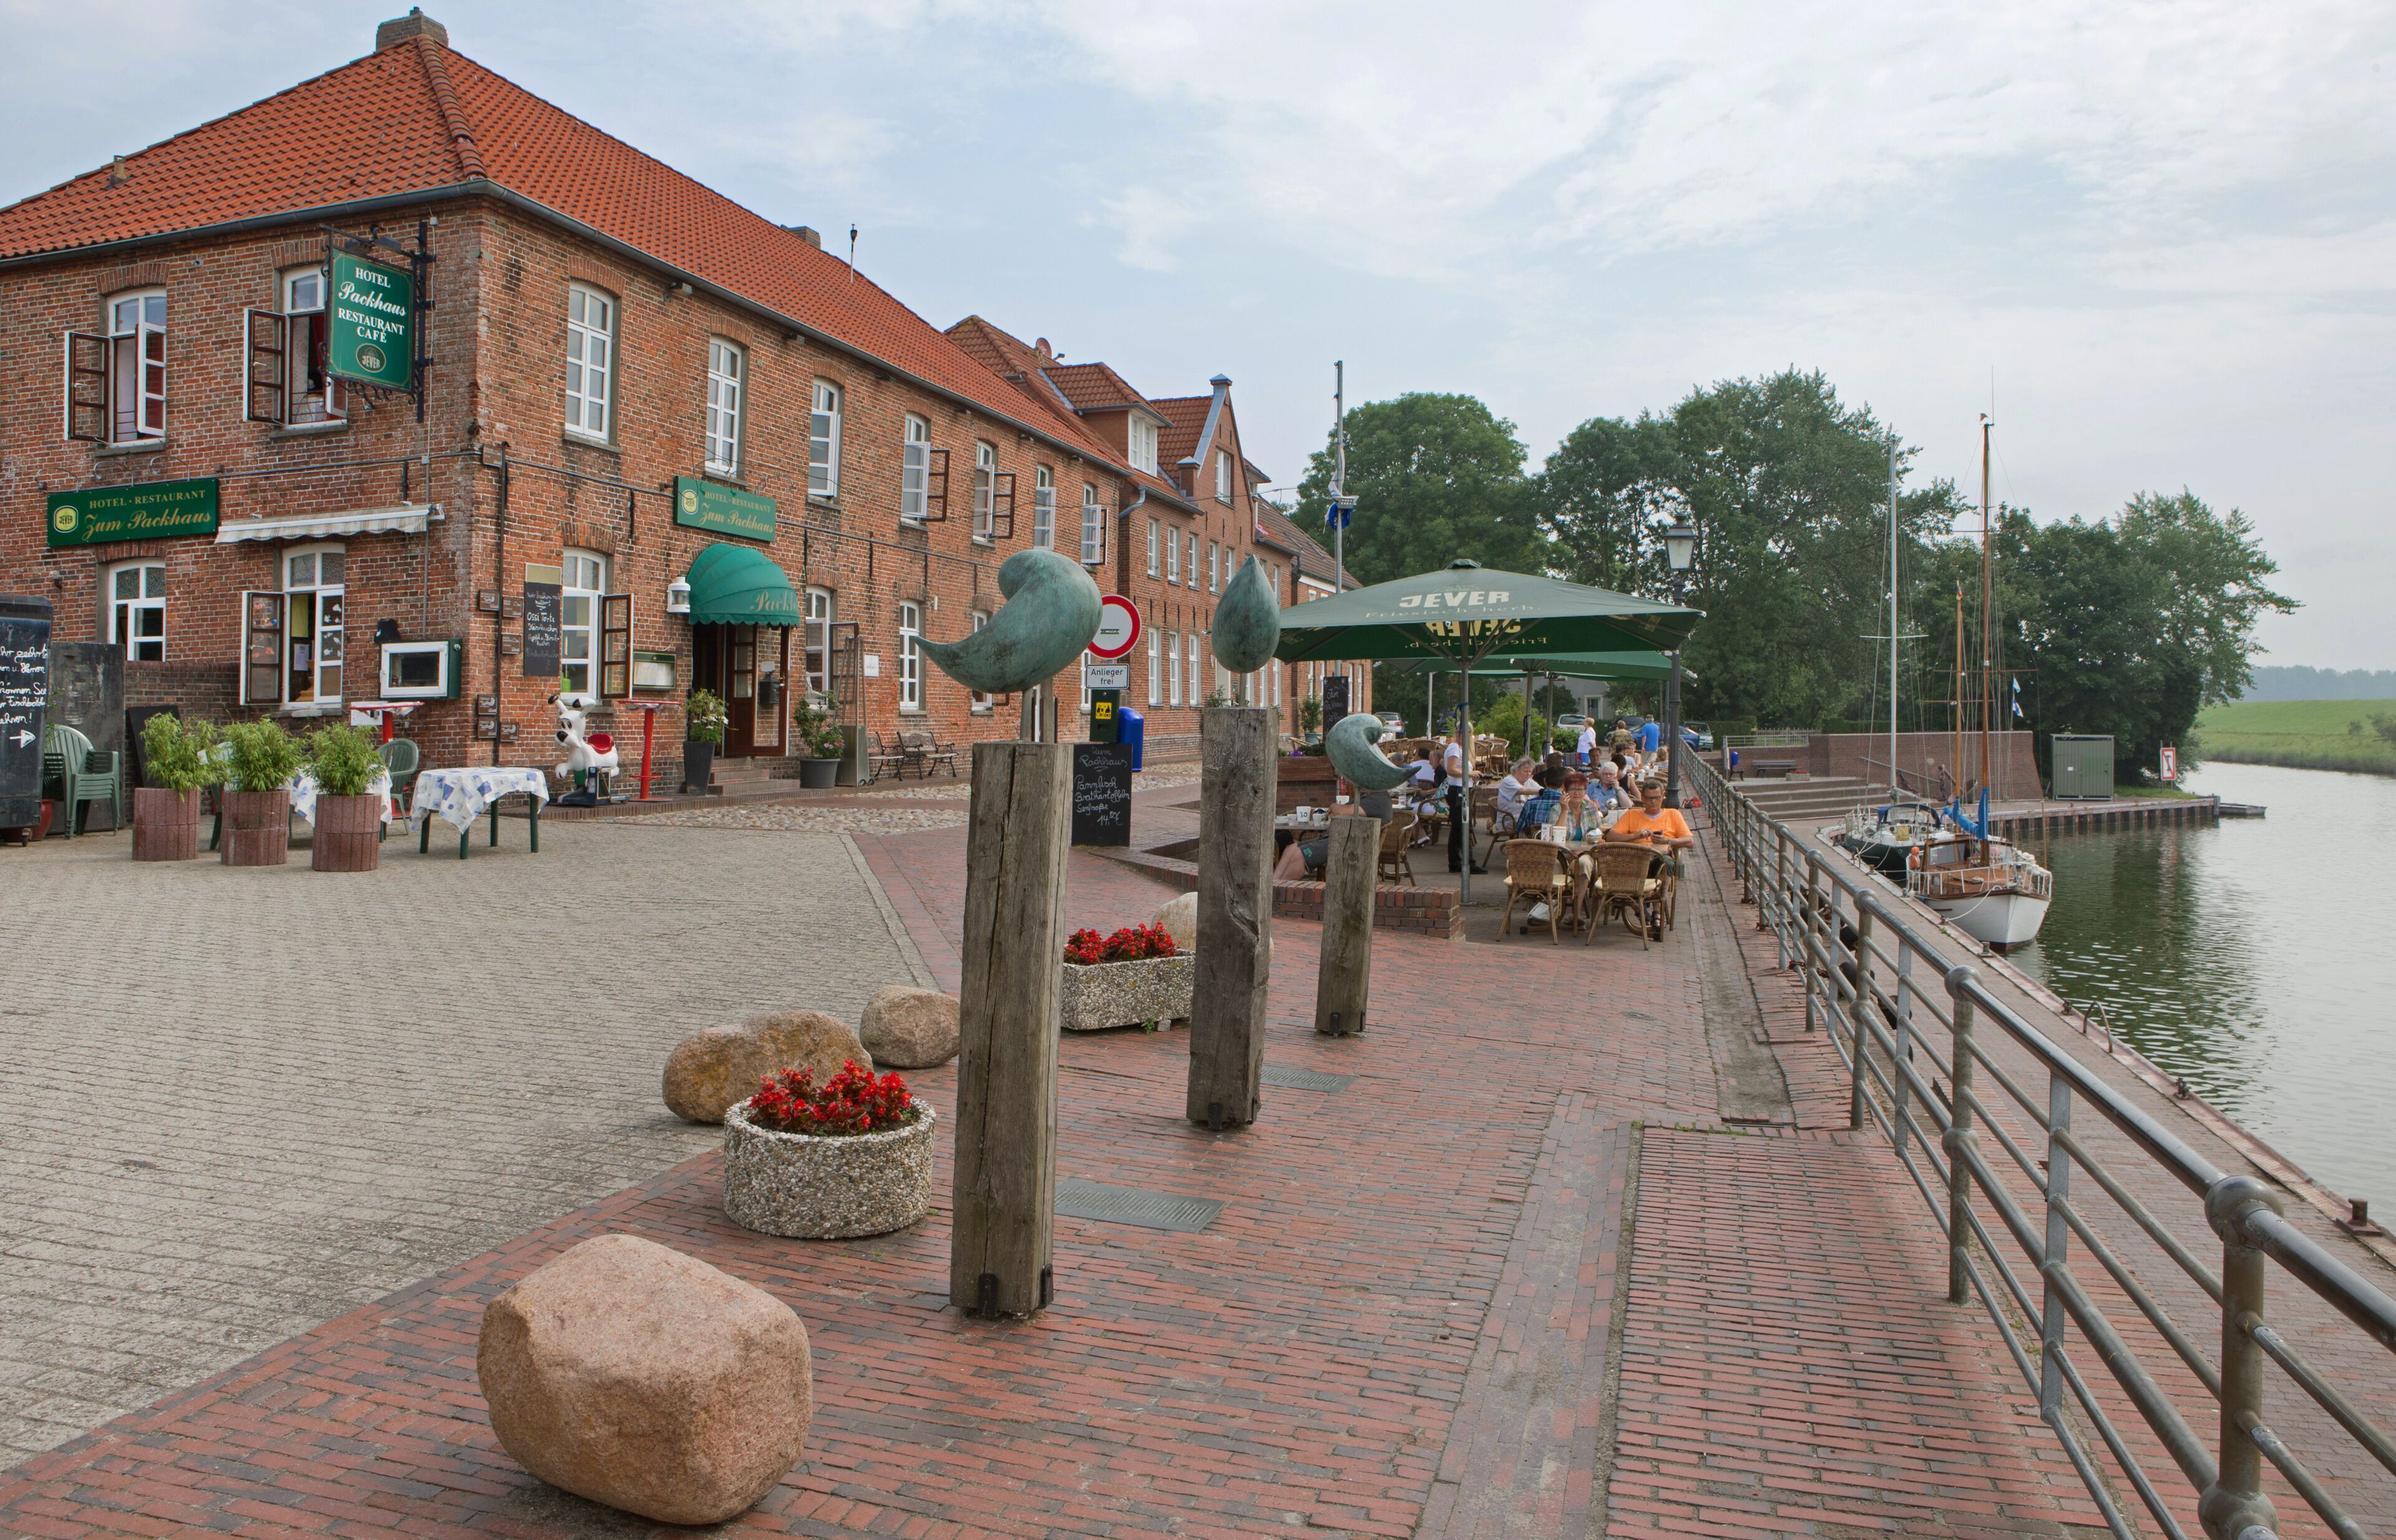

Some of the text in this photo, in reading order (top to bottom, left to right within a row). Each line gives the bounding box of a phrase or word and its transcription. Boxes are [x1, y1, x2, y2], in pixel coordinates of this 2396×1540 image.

[355, 267, 391, 288] HOTEL
[338, 281, 406, 316] Packhaus
[338, 308, 404, 335] RESTAURANT
[357, 326, 387, 343] CAFÉ
[362, 355, 381, 369] JEVER
[89, 490, 206, 509] HOTEL RESTAURANT
[705, 491, 771, 513] HOTEL RESTAURANT
[59, 515, 74, 525] JEVER
[82, 508, 212, 541] Zum Packhaus
[699, 502, 774, 533] Zum Packhaus
[1399, 591, 1510, 608] JEVER
[1091, 668, 1124, 678] Anlieger
[1100, 677, 1114, 685] frei
[33, 682, 47, 695] Sie
[1074, 774, 1118, 793] Pannfisch
